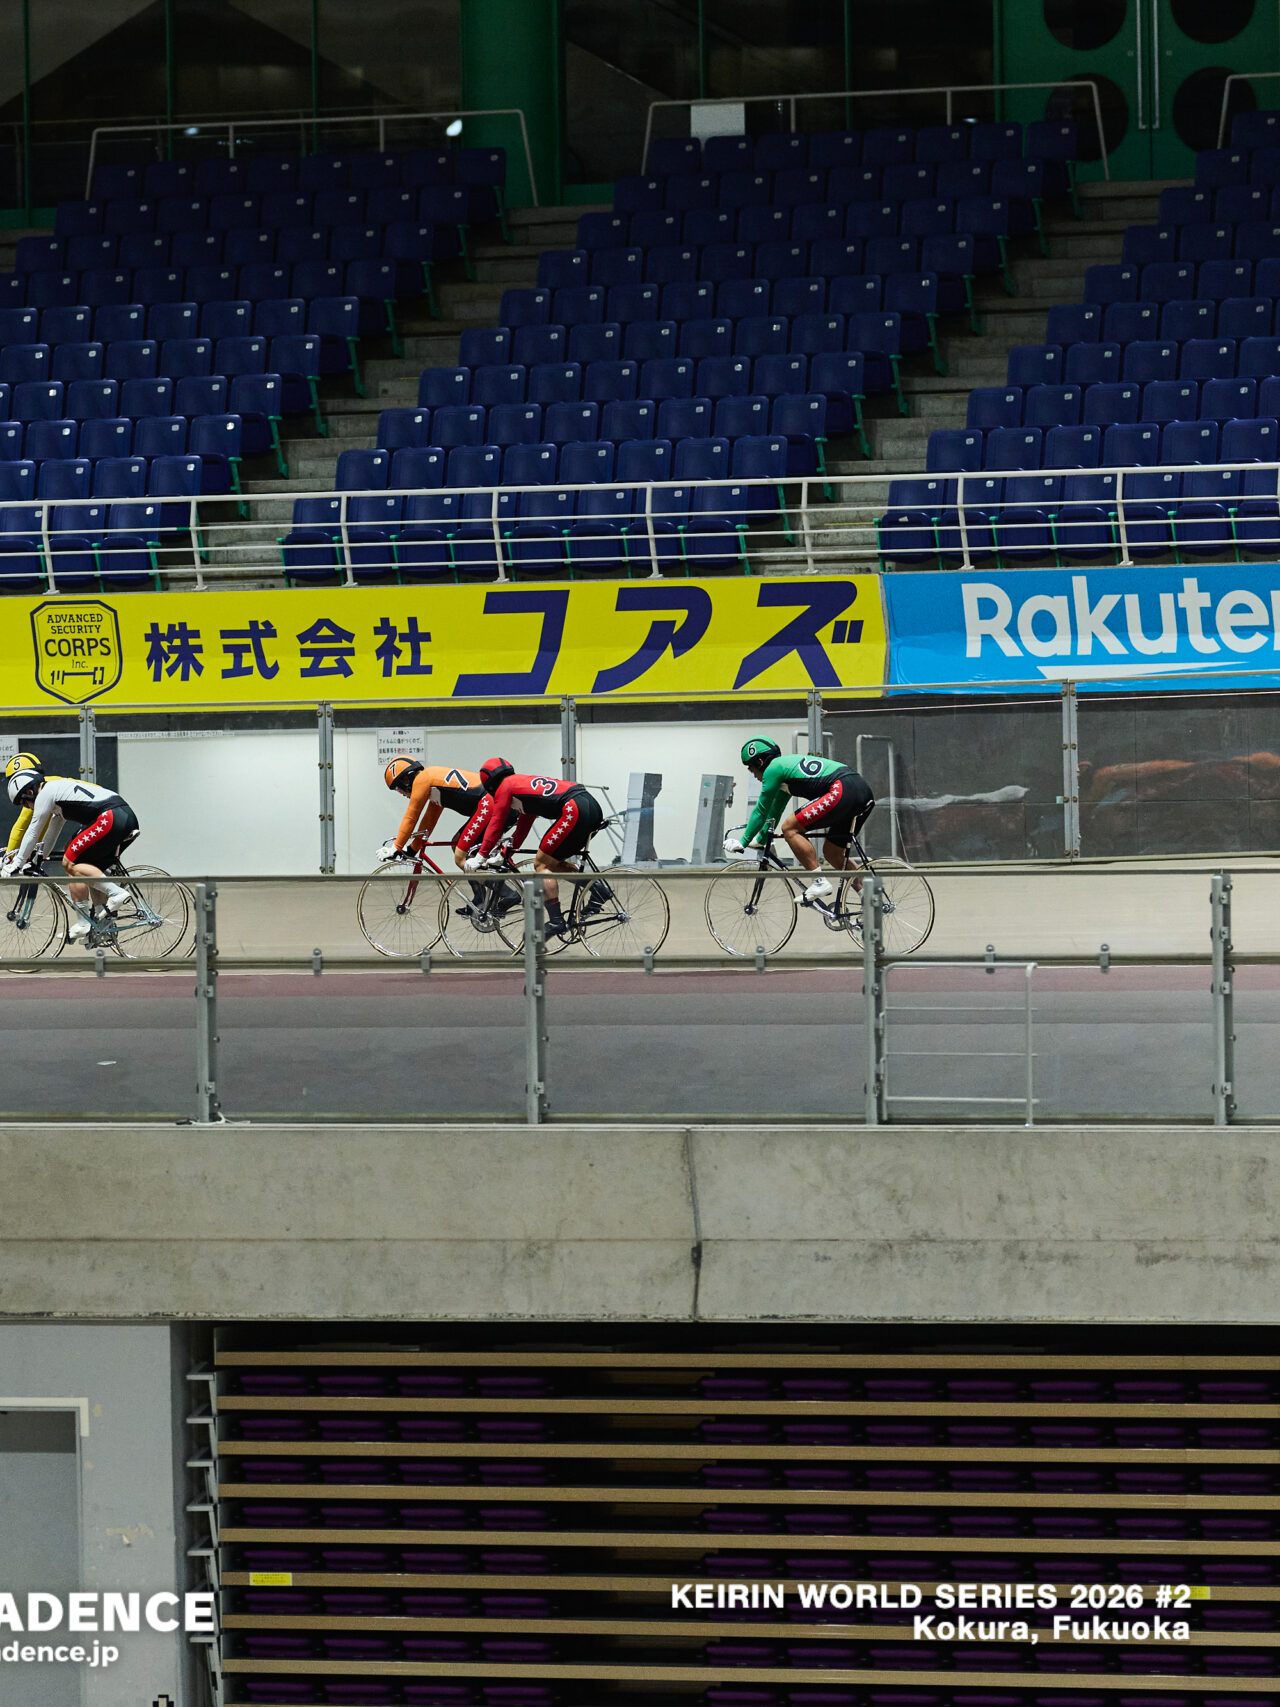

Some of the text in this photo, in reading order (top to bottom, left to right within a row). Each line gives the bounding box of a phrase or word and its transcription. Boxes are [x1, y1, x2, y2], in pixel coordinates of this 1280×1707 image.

[47, 613, 103, 623] ADVANCED
[961, 576, 1280, 658] Rakute
[51, 625, 101, 634] SECURITY
[144, 580, 864, 697] 株式会社 コアズ
[44, 637, 111, 657] CORPS
[72, 659, 88, 668] Inc.
[747, 742, 757, 756] 6
[13, 758, 21, 771] 5
[389, 762, 397, 778] 7
[799, 756, 824, 777] 6
[13, 780, 19, 791] 1
[445, 769, 470, 791] 7
[531, 777, 558, 797] 3
[74, 785, 95, 799] 1
